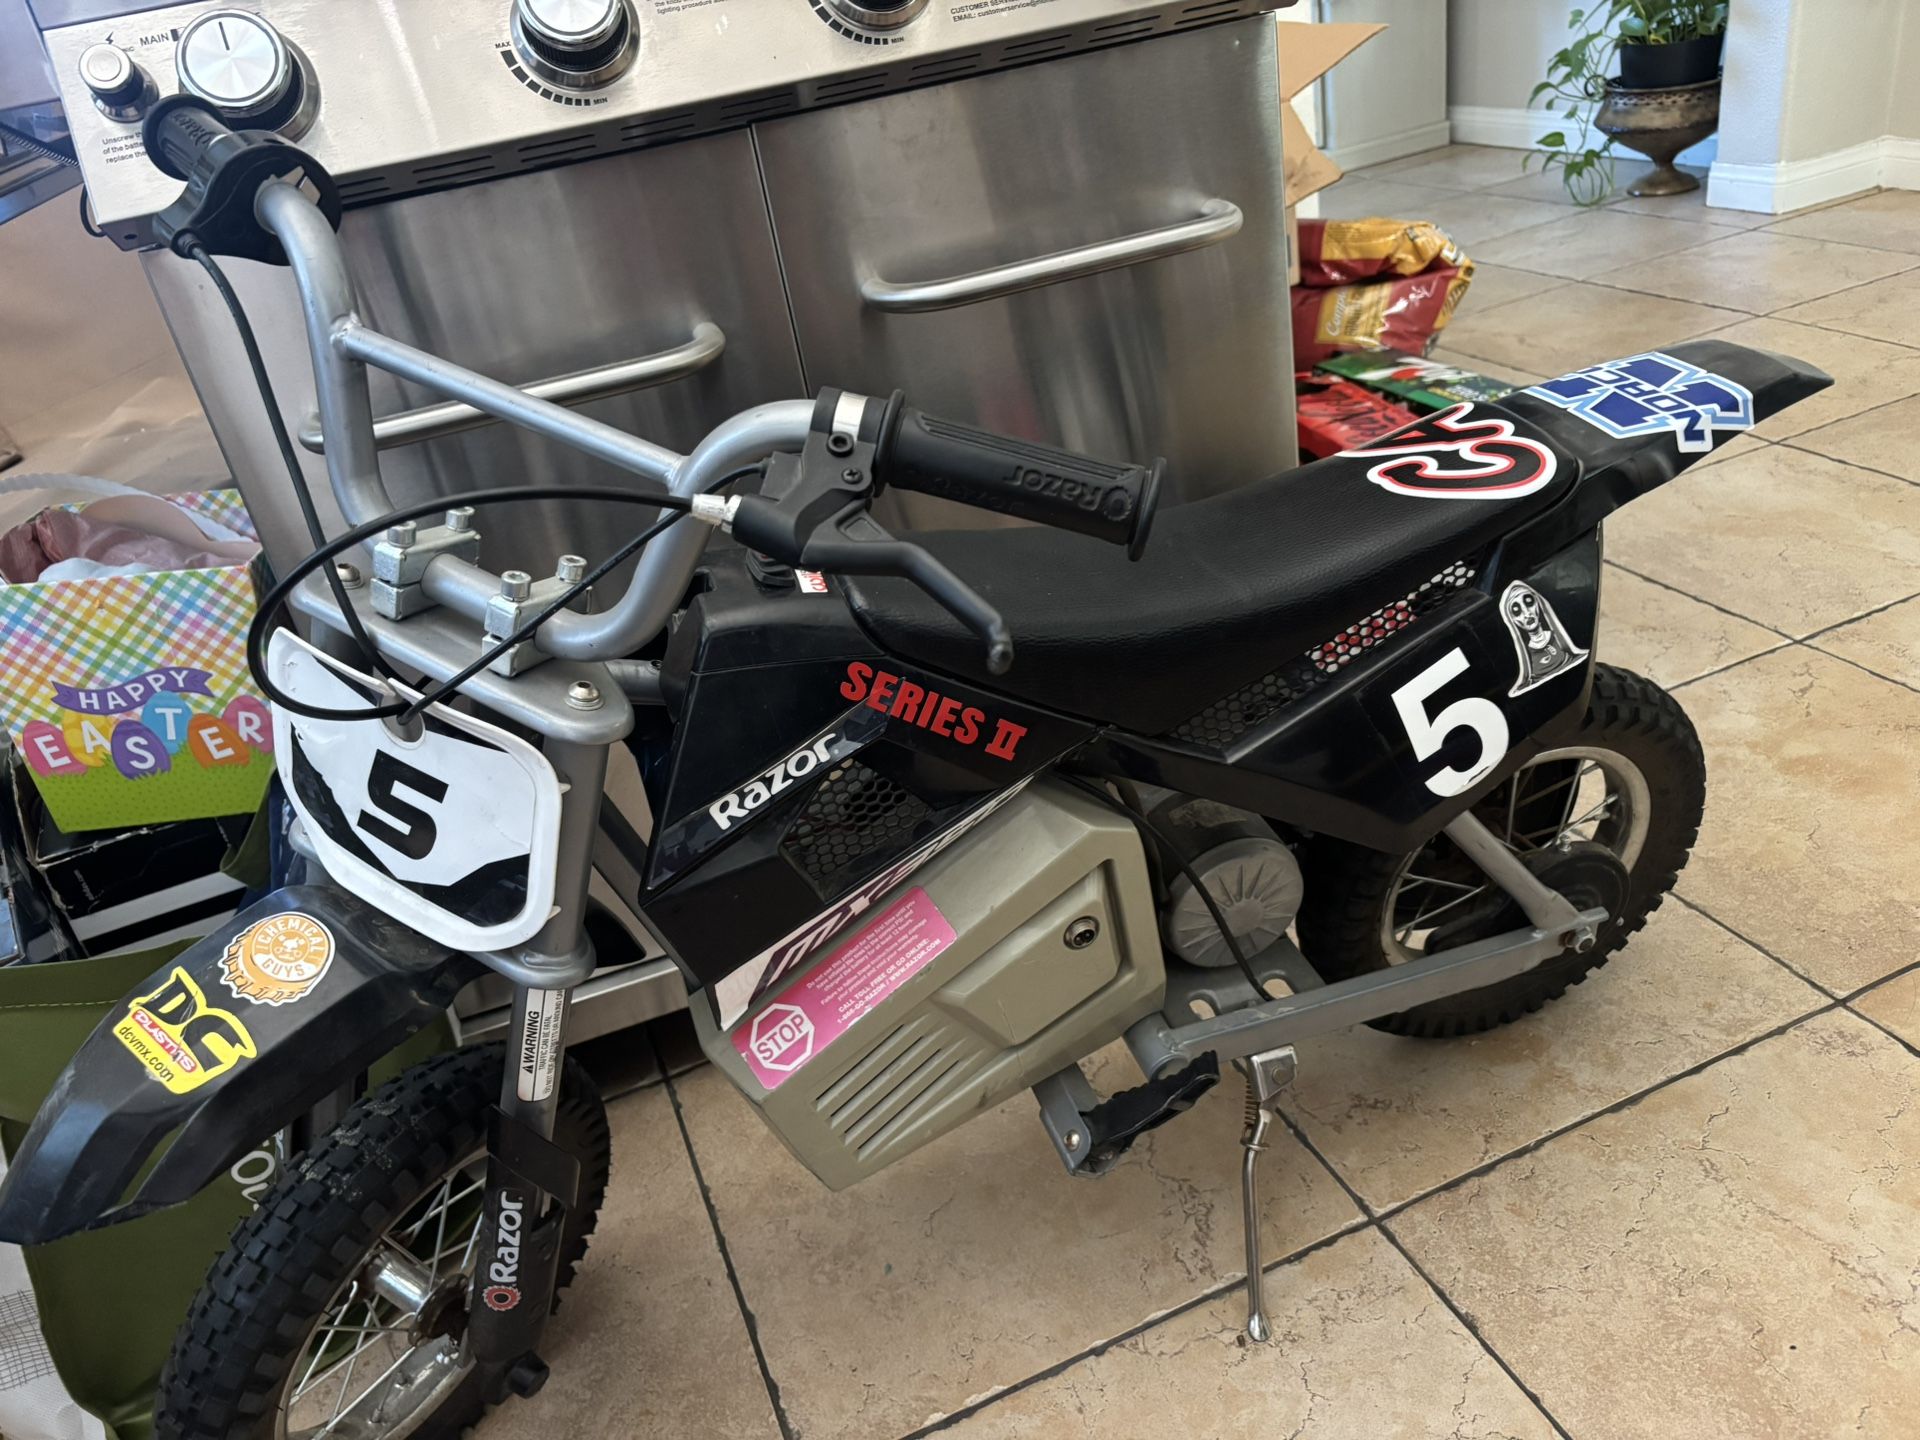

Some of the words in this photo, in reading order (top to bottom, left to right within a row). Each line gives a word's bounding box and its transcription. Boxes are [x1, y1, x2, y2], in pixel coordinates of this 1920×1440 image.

[950, 0, 990, 15] CUSTOMER
[139, 33, 170, 47] MAIN
[494, 40, 512, 49] MAX
[890, 36, 905, 44] MIN
[592, 96, 609, 105] MIN
[102, 134, 135, 145] Unscrew
[103, 147, 111, 155] of
[106, 153, 134, 164] replace
[1002, 465, 1101, 511] Razor
[78, 669, 190, 710] HAPPY
[840, 661, 986, 745] SERIES
[984, 718, 1028, 761] II
[33, 707, 265, 769] EASTER
[1391, 647, 1509, 797] 5
[357, 748, 449, 860] 5
[709, 732, 837, 831] Razor
[257, 918, 325, 953] CHEMICAL
[262, 957, 306, 978] GUYS
[837, 996, 855, 1013] CALL
[853, 984, 871, 1000] TOLL
[869, 971, 887, 987] FREE
[884, 963, 897, 974] OR
[894, 955, 906, 967] GO
[137, 972, 248, 1073] DC
[522, 1010, 540, 1063] WARNING
[757, 1013, 805, 1061] STOP
[118, 1025, 175, 1083] dcvmx.com
[490, 1190, 523, 1282] Razor
